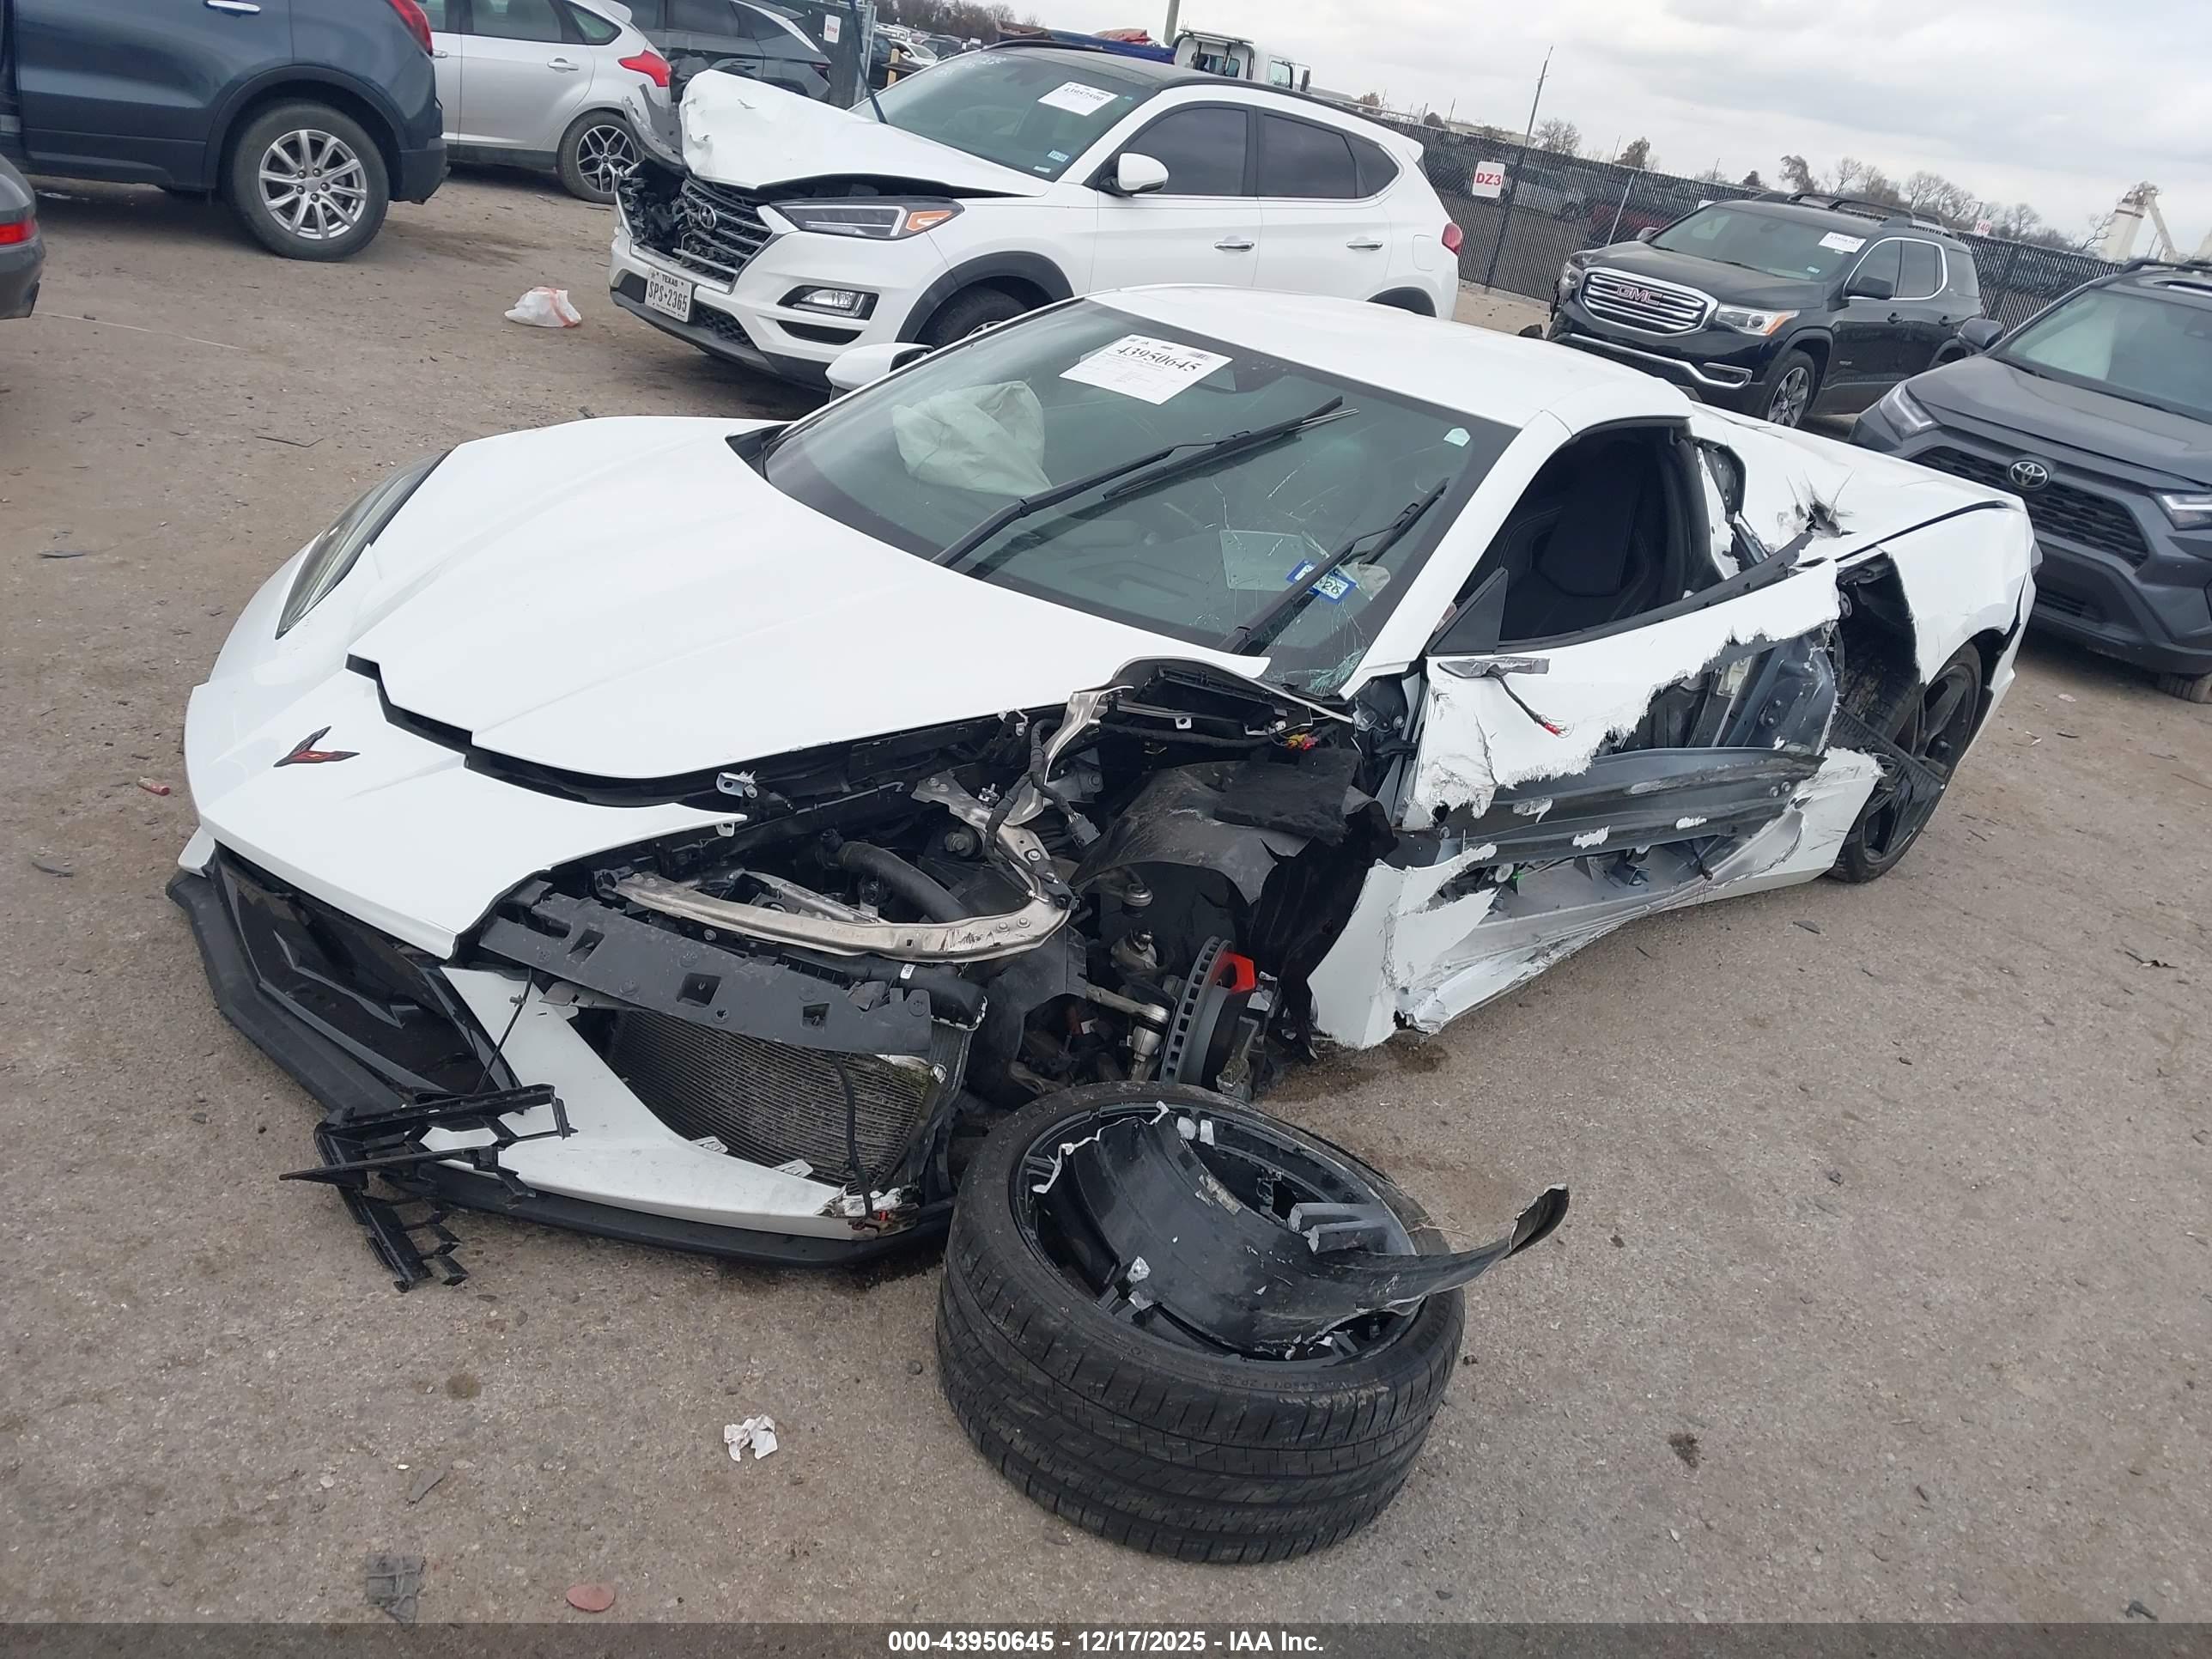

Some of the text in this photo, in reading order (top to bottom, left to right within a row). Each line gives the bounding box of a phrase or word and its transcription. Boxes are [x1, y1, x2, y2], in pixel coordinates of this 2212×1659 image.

[1475, 173, 1502, 186] DZ3
[1976, 222, 1990, 232] 140
[662, 274, 678, 288] TEXAS
[1616, 284, 1663, 307] GMC
[1116, 345, 1202, 372] 43950645
